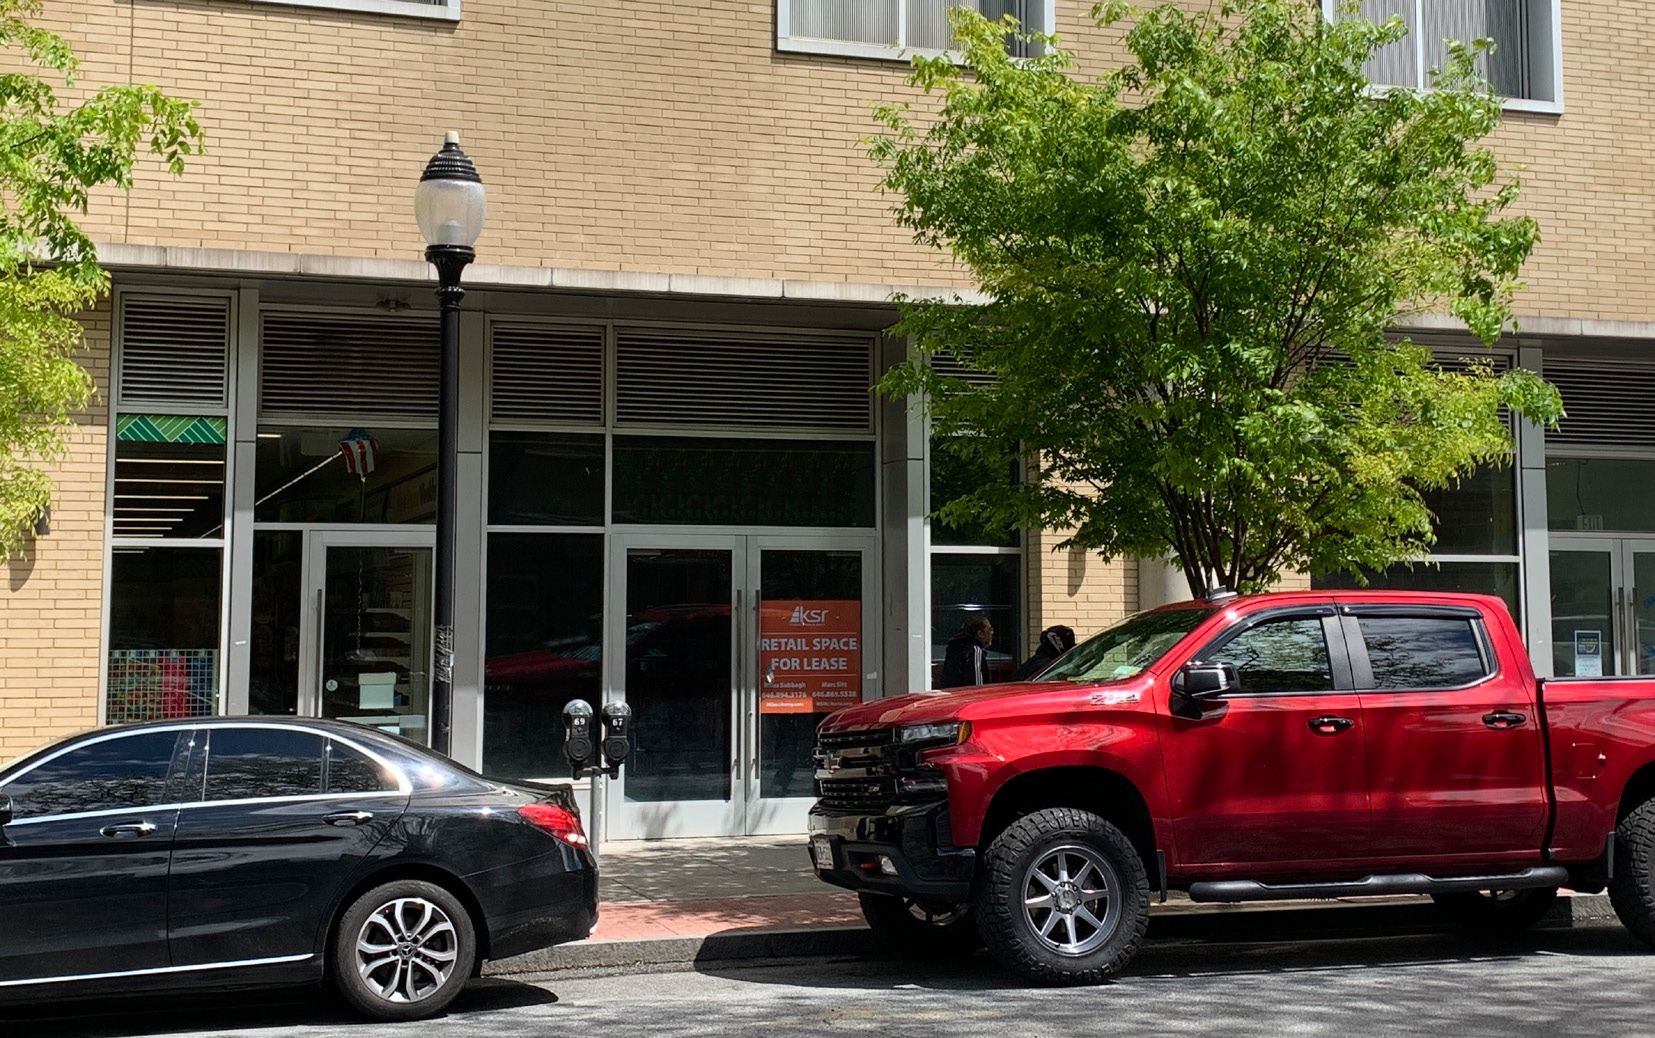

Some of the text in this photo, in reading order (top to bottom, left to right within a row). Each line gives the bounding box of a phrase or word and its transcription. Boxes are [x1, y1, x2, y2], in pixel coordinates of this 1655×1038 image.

[800, 606, 829, 623] ksr
[761, 637, 857, 651] RETAIL SPACE
[771, 657, 847, 670] FOR LEASE
[574, 717, 586, 726] 69
[612, 718, 624, 726] 67
